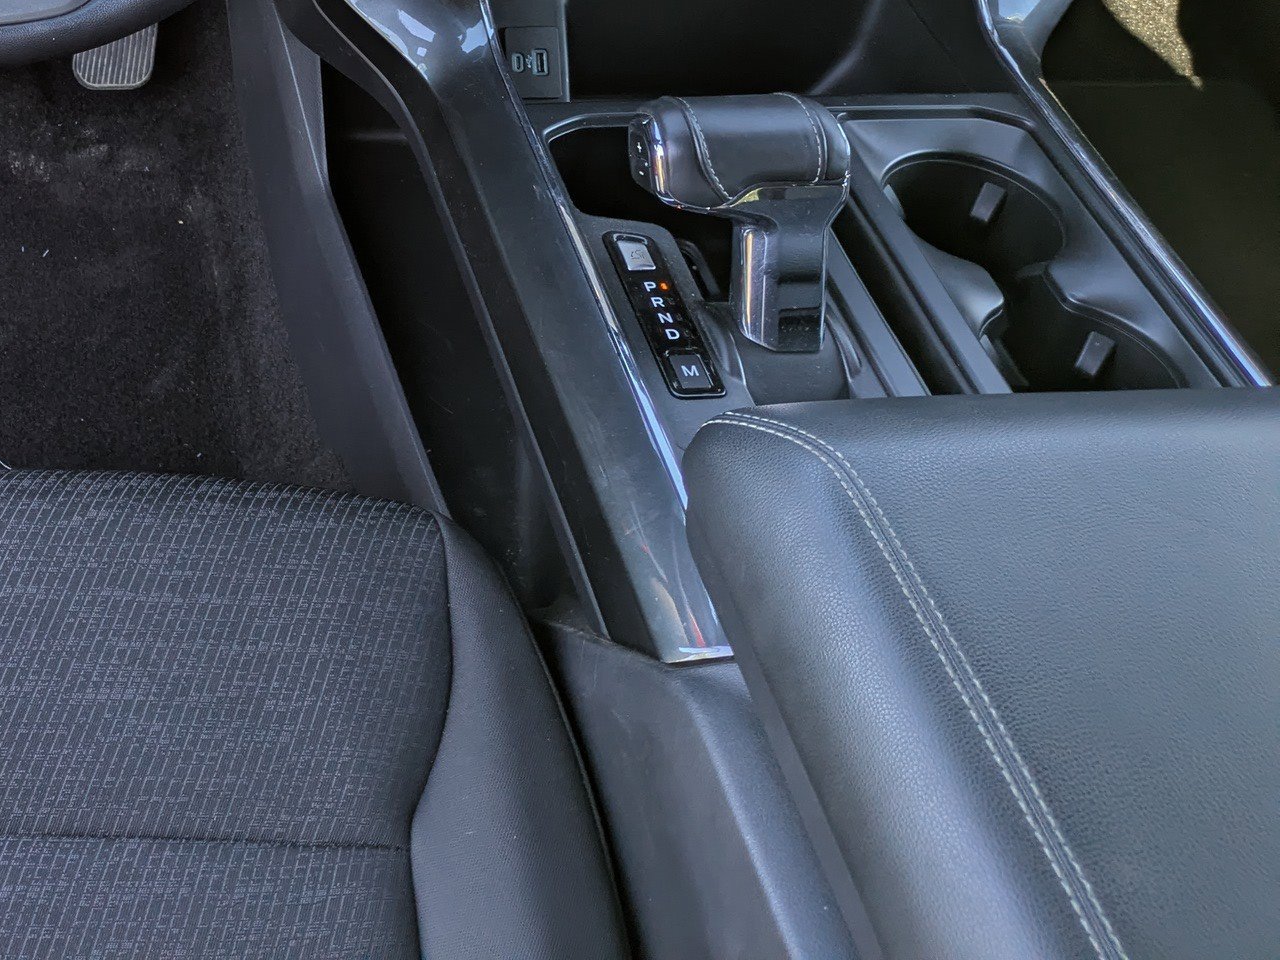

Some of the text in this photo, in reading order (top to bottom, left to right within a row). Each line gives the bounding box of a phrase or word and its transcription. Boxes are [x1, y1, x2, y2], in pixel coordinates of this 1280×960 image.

[643, 281, 657, 292] P
[650, 296, 666, 309] R
[657, 312, 674, 324] N
[665, 328, 680, 341] D
[680, 364, 700, 377] M
